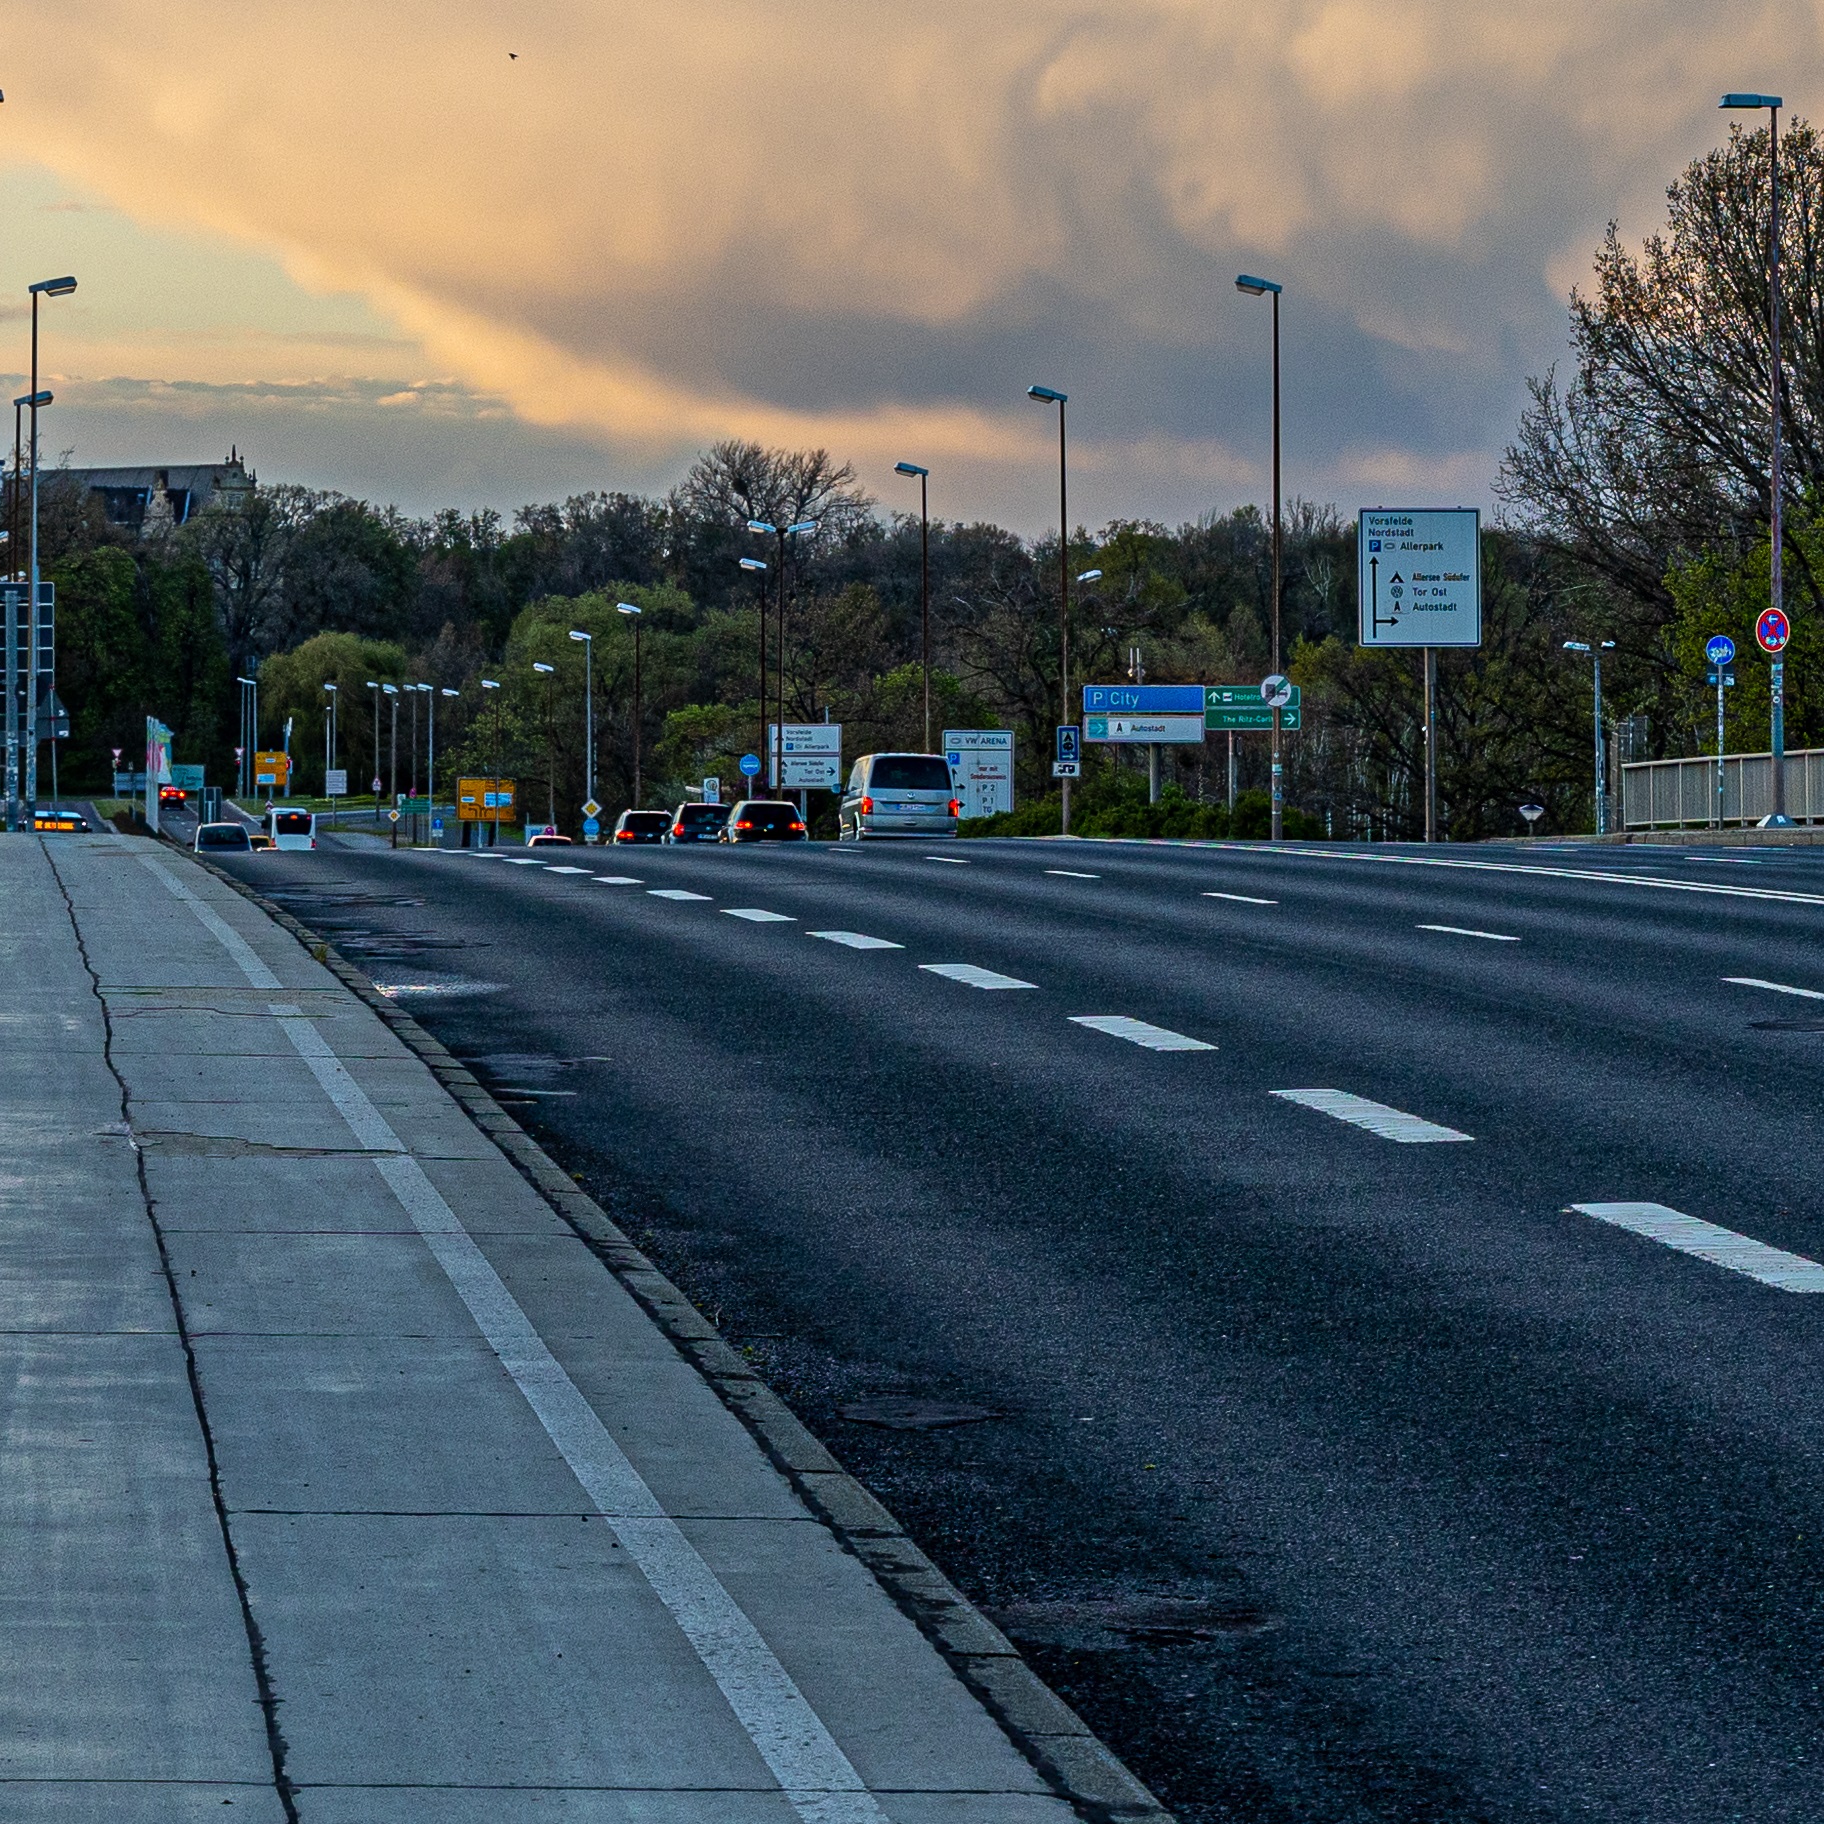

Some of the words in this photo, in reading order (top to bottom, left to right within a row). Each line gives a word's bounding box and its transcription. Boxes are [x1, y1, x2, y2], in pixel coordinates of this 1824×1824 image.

[1368, 516, 1413, 525] Vorsfelde
[1368, 528, 1414, 537] Nordstadt
[1399, 541, 1444, 552] Allerpark
[1412, 587, 1427, 596] Tor
[1431, 587, 1447, 596] Ost
[1412, 602, 1457, 611] Autostadt
[1093, 691, 1103, 705] P
[1110, 691, 1139, 709] City
[1223, 715, 1235, 723] The
[1131, 724, 1166, 733] Autostadt
[982, 784, 988, 792] P
